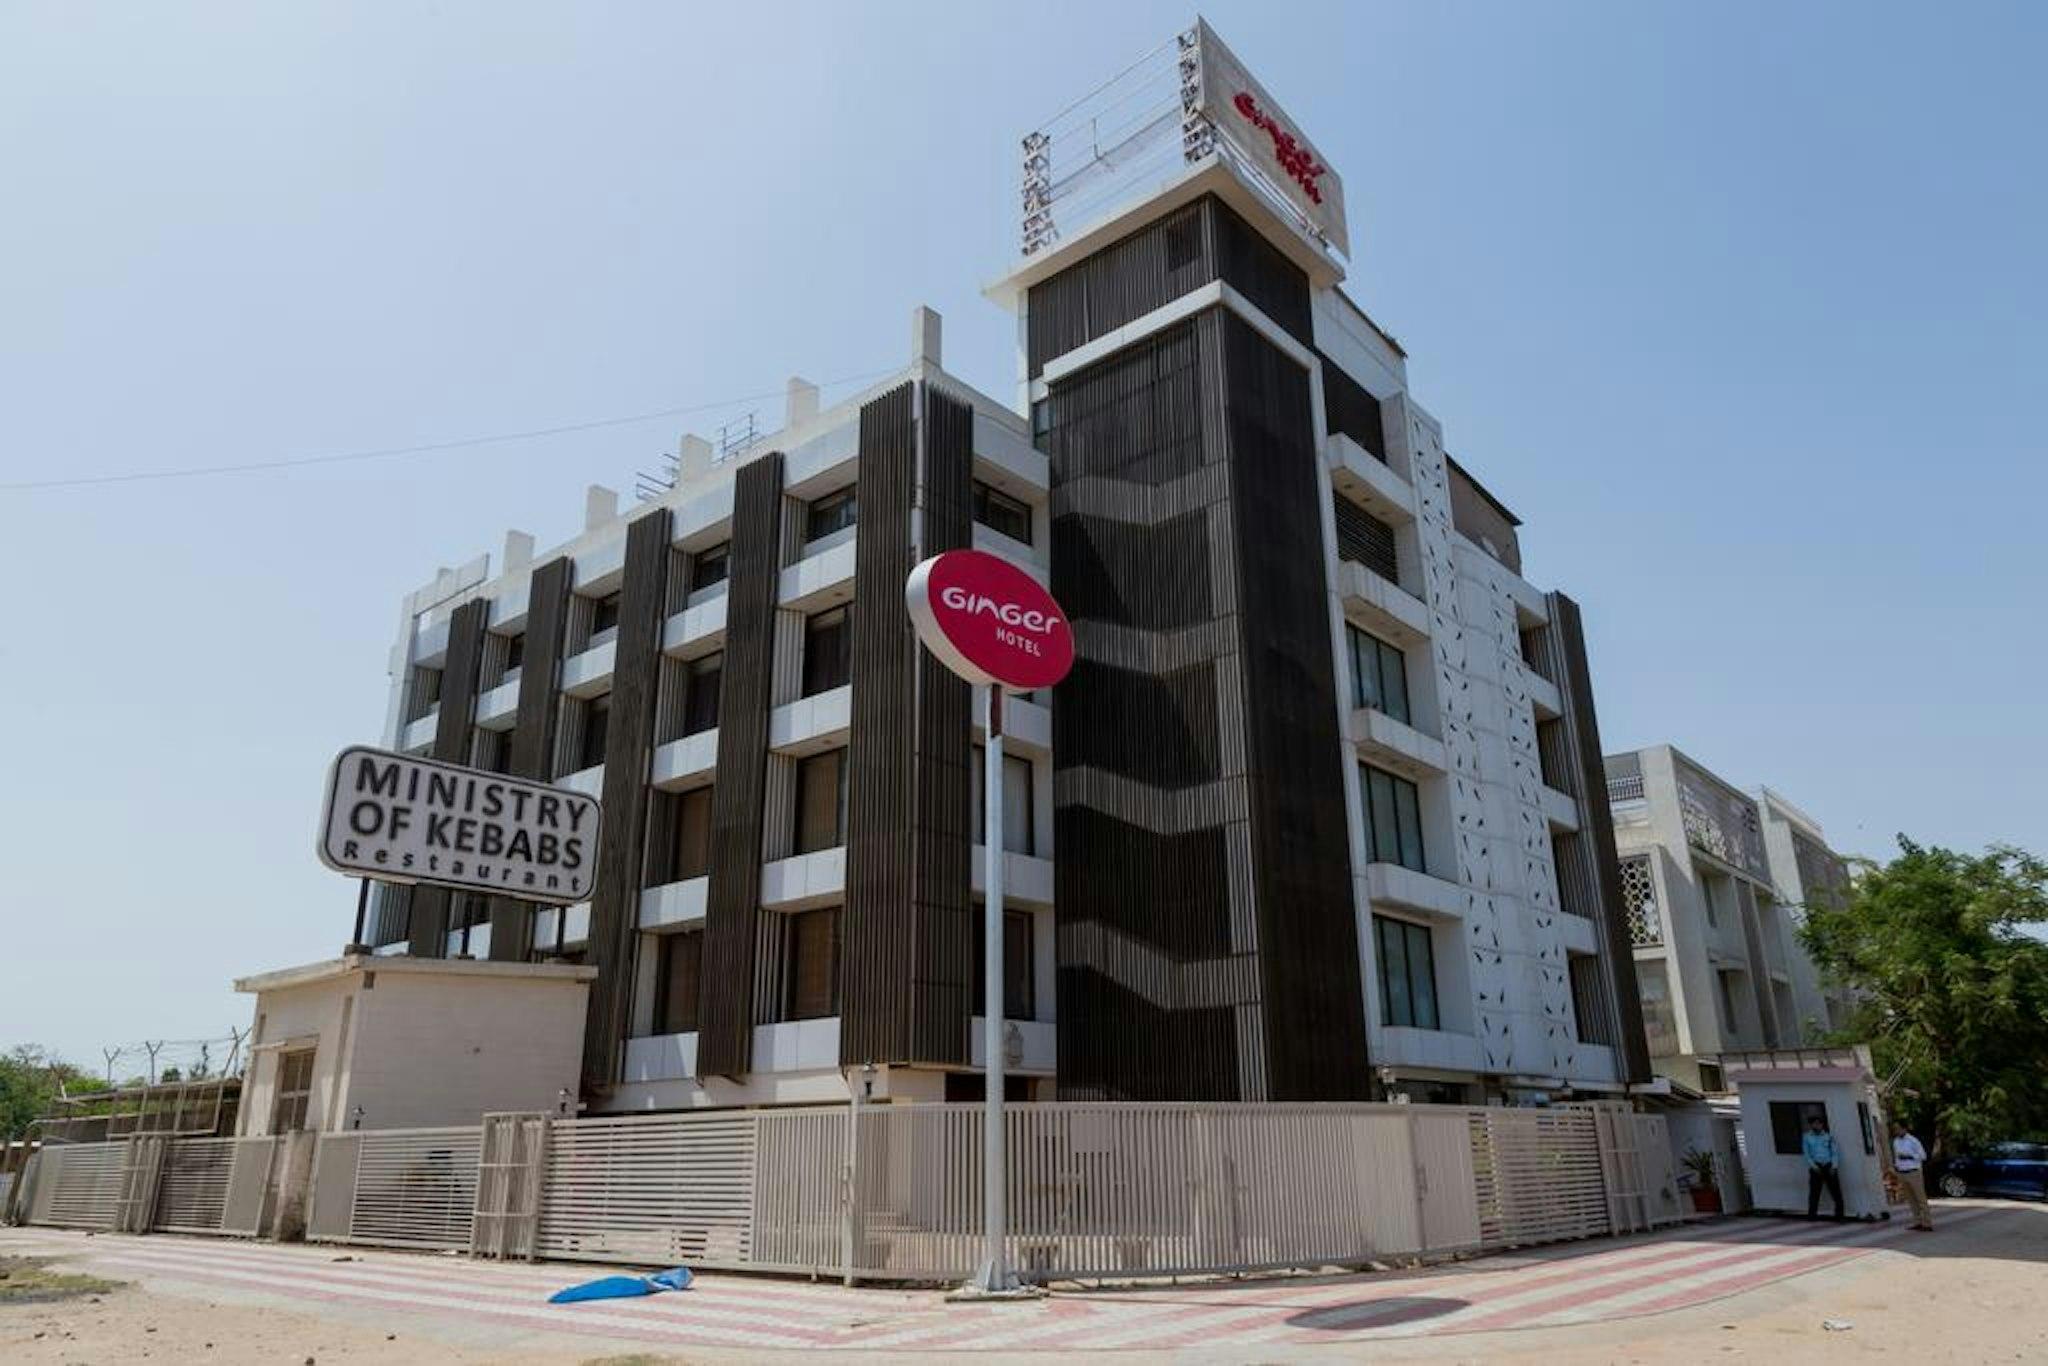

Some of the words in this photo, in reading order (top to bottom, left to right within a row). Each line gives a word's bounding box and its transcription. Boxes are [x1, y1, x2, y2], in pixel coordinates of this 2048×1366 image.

[996, 628, 1041, 657] HOTEL
[356, 757, 588, 832] MINISTRY
[350, 801, 411, 840] OF
[426, 812, 582, 869] KEBABS
[344, 840, 579, 892] Restaurant
